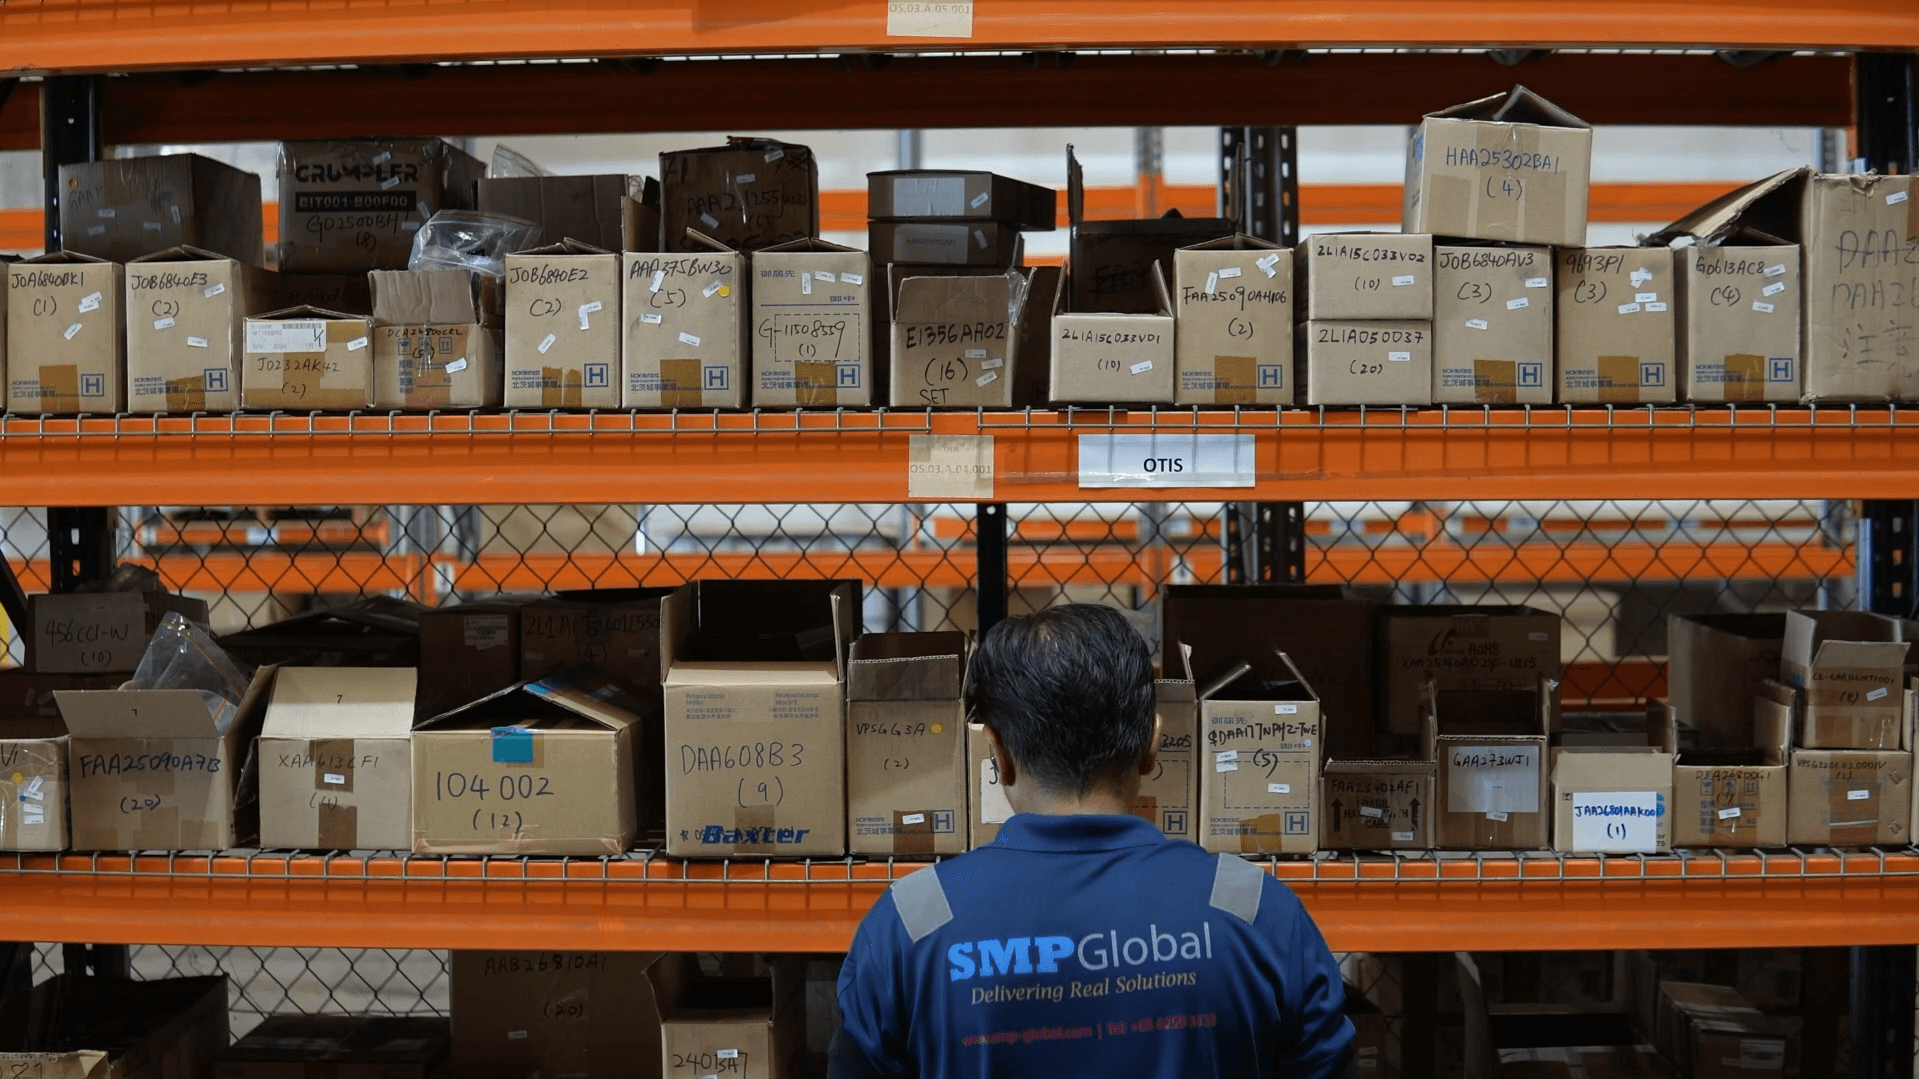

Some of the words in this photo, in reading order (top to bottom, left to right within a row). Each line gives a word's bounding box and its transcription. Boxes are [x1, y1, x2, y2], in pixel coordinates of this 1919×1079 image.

[1486, 176, 1523, 200] (4)
[919, 388, 950, 407] SET
[1143, 458, 1184, 473] OTIS
[701, 826, 810, 844] Baxter
[947, 935, 1075, 982] SMP
[1077, 922, 1212, 970] Global
[971, 983, 1064, 1005] Delivering
[1070, 978, 1110, 999] Real
[1115, 969, 1197, 994] Solutions
